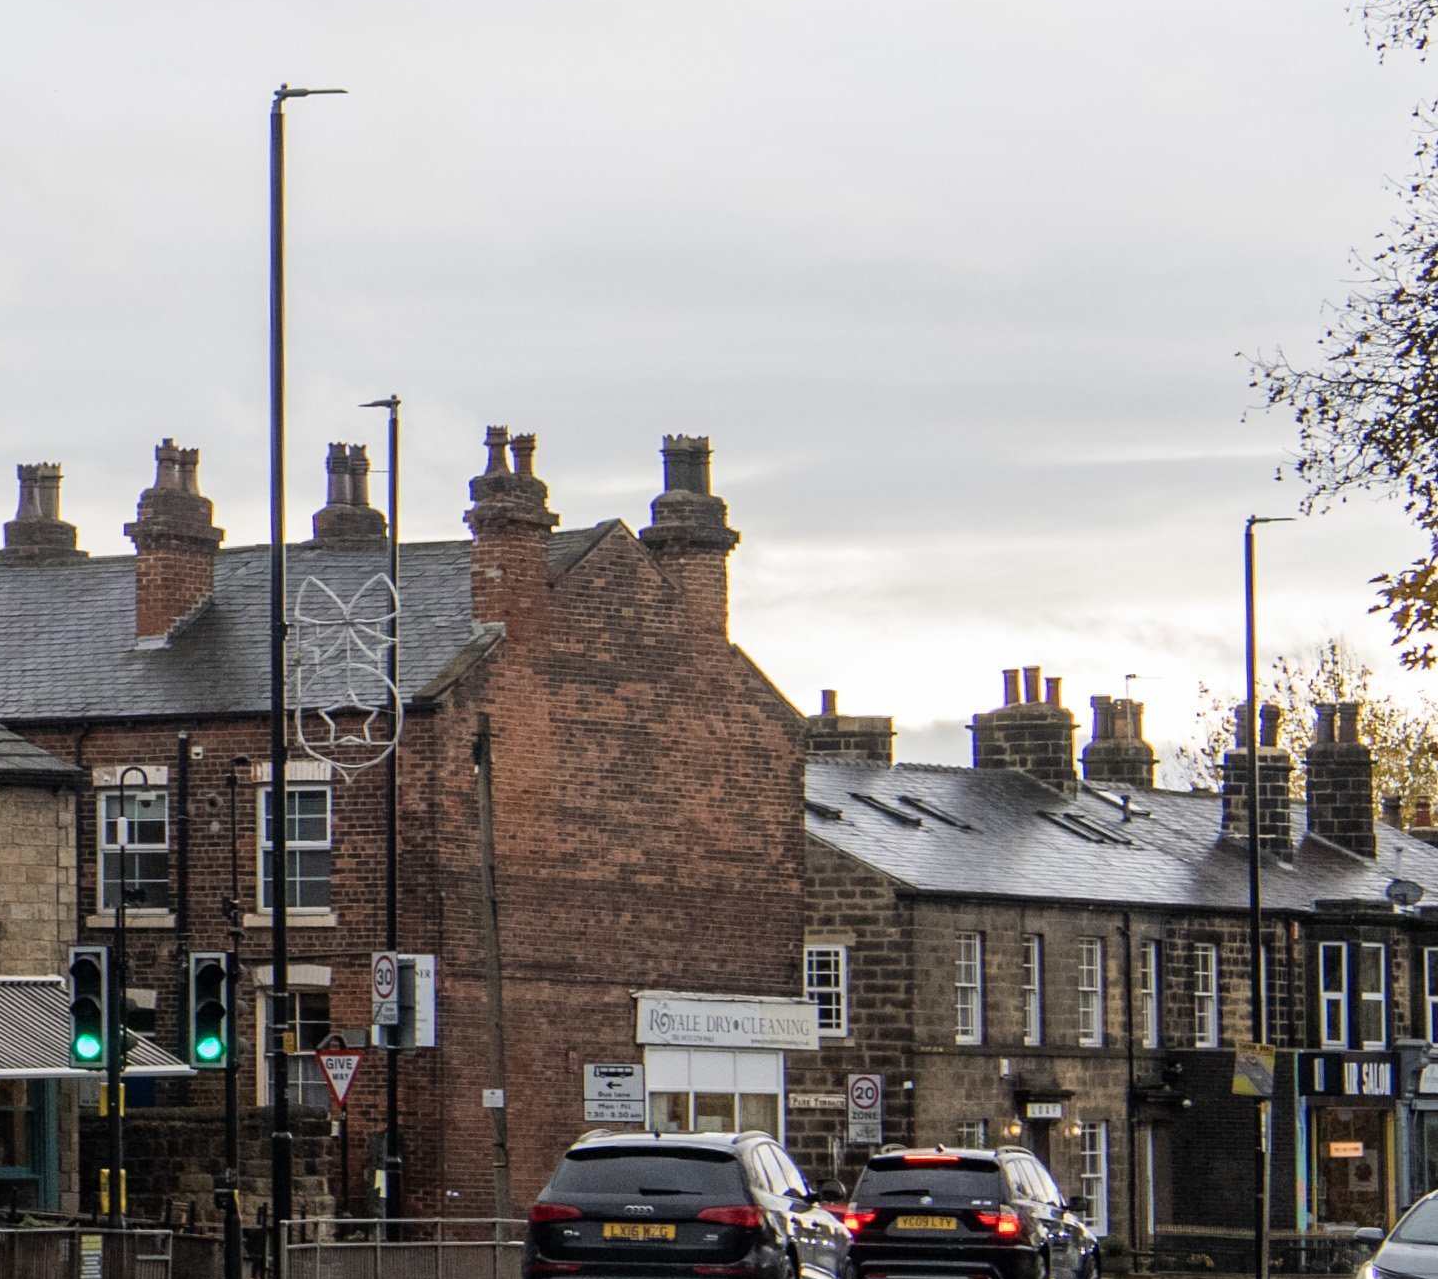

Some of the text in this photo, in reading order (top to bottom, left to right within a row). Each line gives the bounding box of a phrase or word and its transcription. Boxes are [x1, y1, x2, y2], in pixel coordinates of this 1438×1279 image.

[376, 969, 393, 985] 30
[649, 1008, 810, 1035] ROYALE DRY CLEANING
[326, 1058, 353, 1070] GIVE
[1362, 1062, 1392, 1095] SALON
[855, 1087, 875, 1100] 20
[852, 1111, 877, 1120] ZONE
